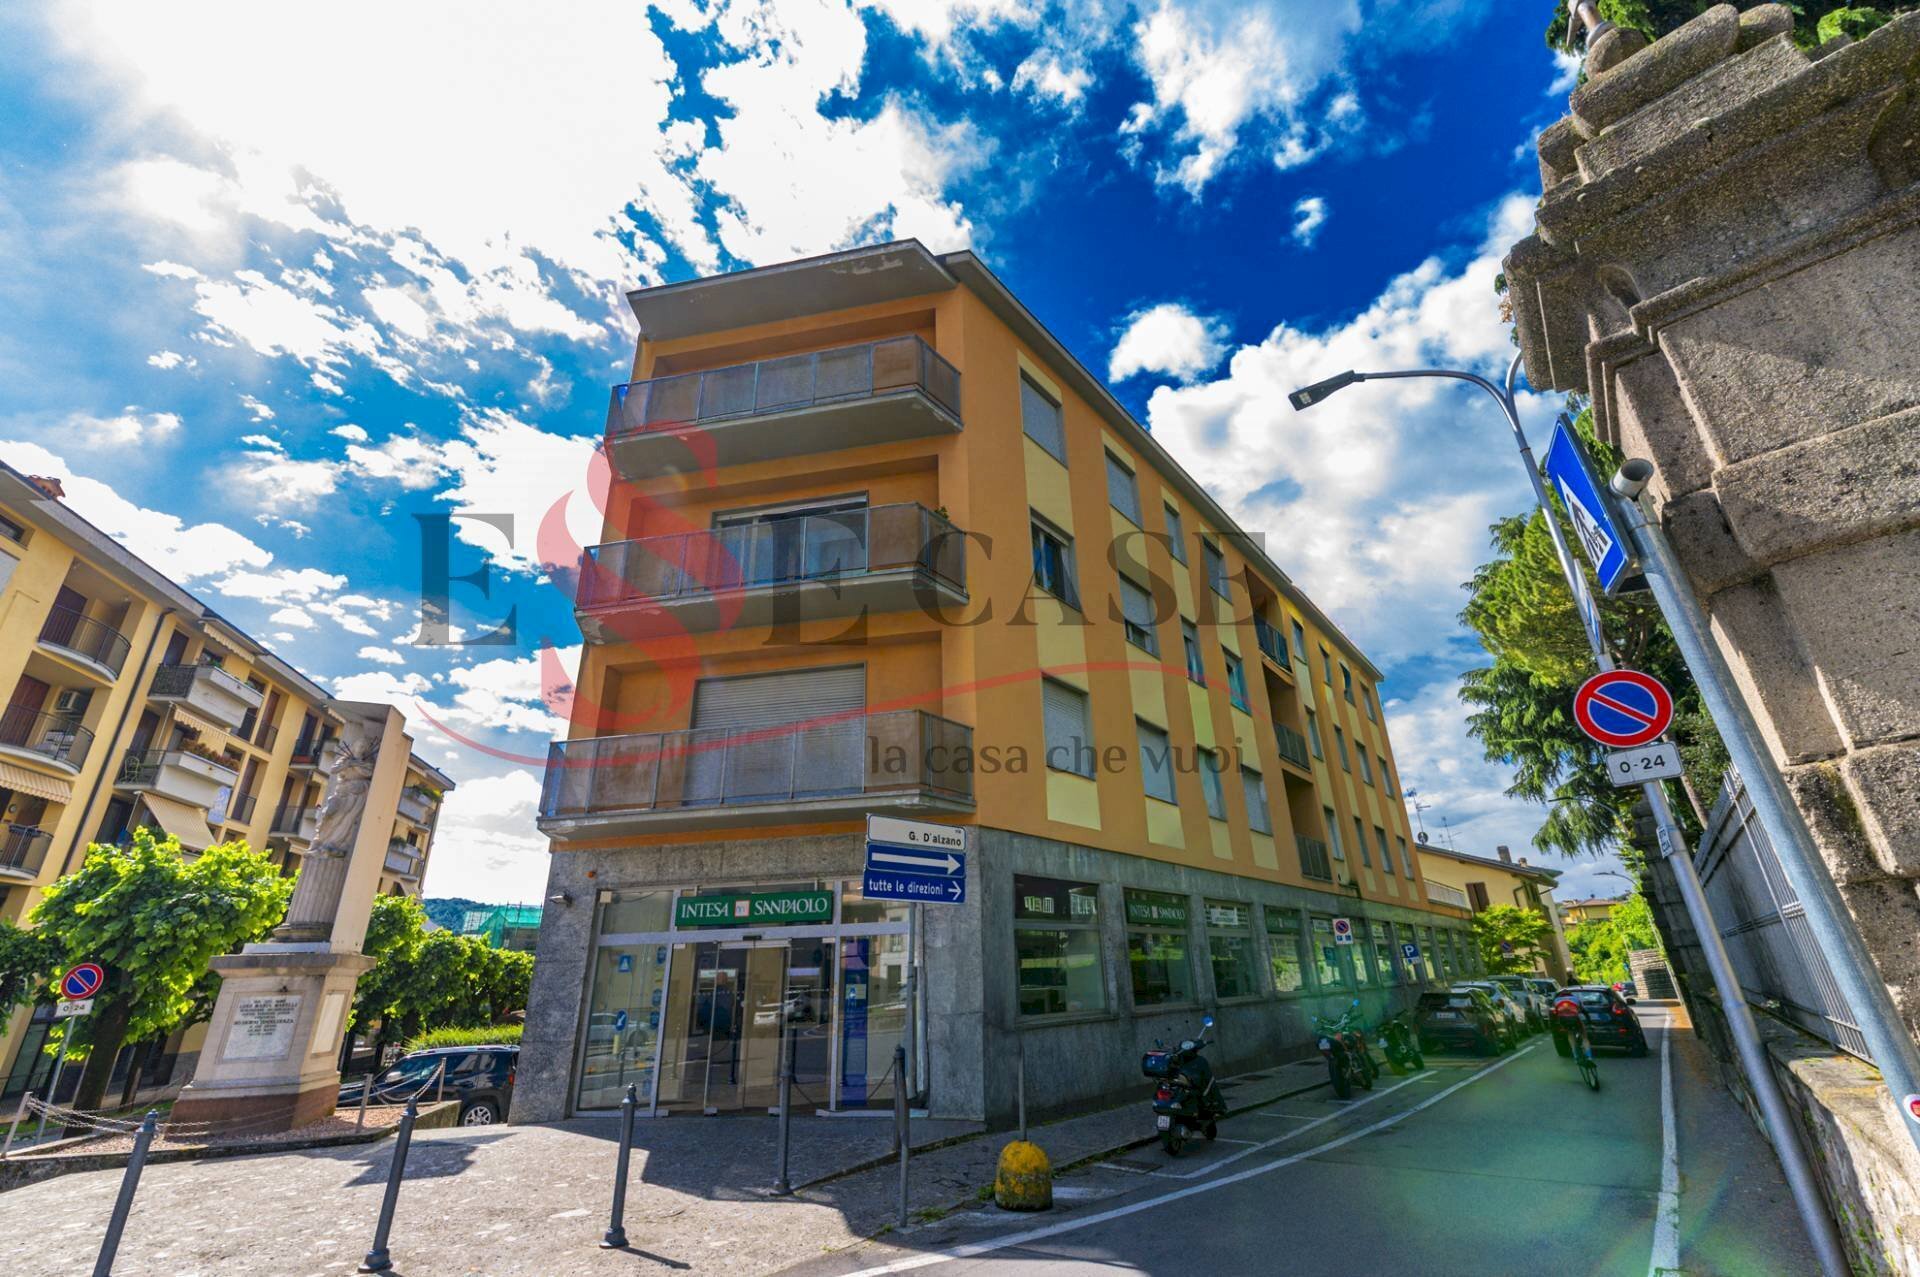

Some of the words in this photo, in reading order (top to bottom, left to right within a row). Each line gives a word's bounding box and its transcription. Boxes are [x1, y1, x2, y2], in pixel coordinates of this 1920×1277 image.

[1619, 754, 1666, 773] 0-24
[908, 831, 919, 842] G.
[923, 832, 962, 847] D'alzano
[868, 879, 893, 892] tutte
[895, 880, 905, 893] le
[907, 881, 944, 896] direzioni
[681, 902, 729, 919] INTESA
[754, 897, 828, 916] SANPAOLO
[1404, 944, 1415, 957] P
